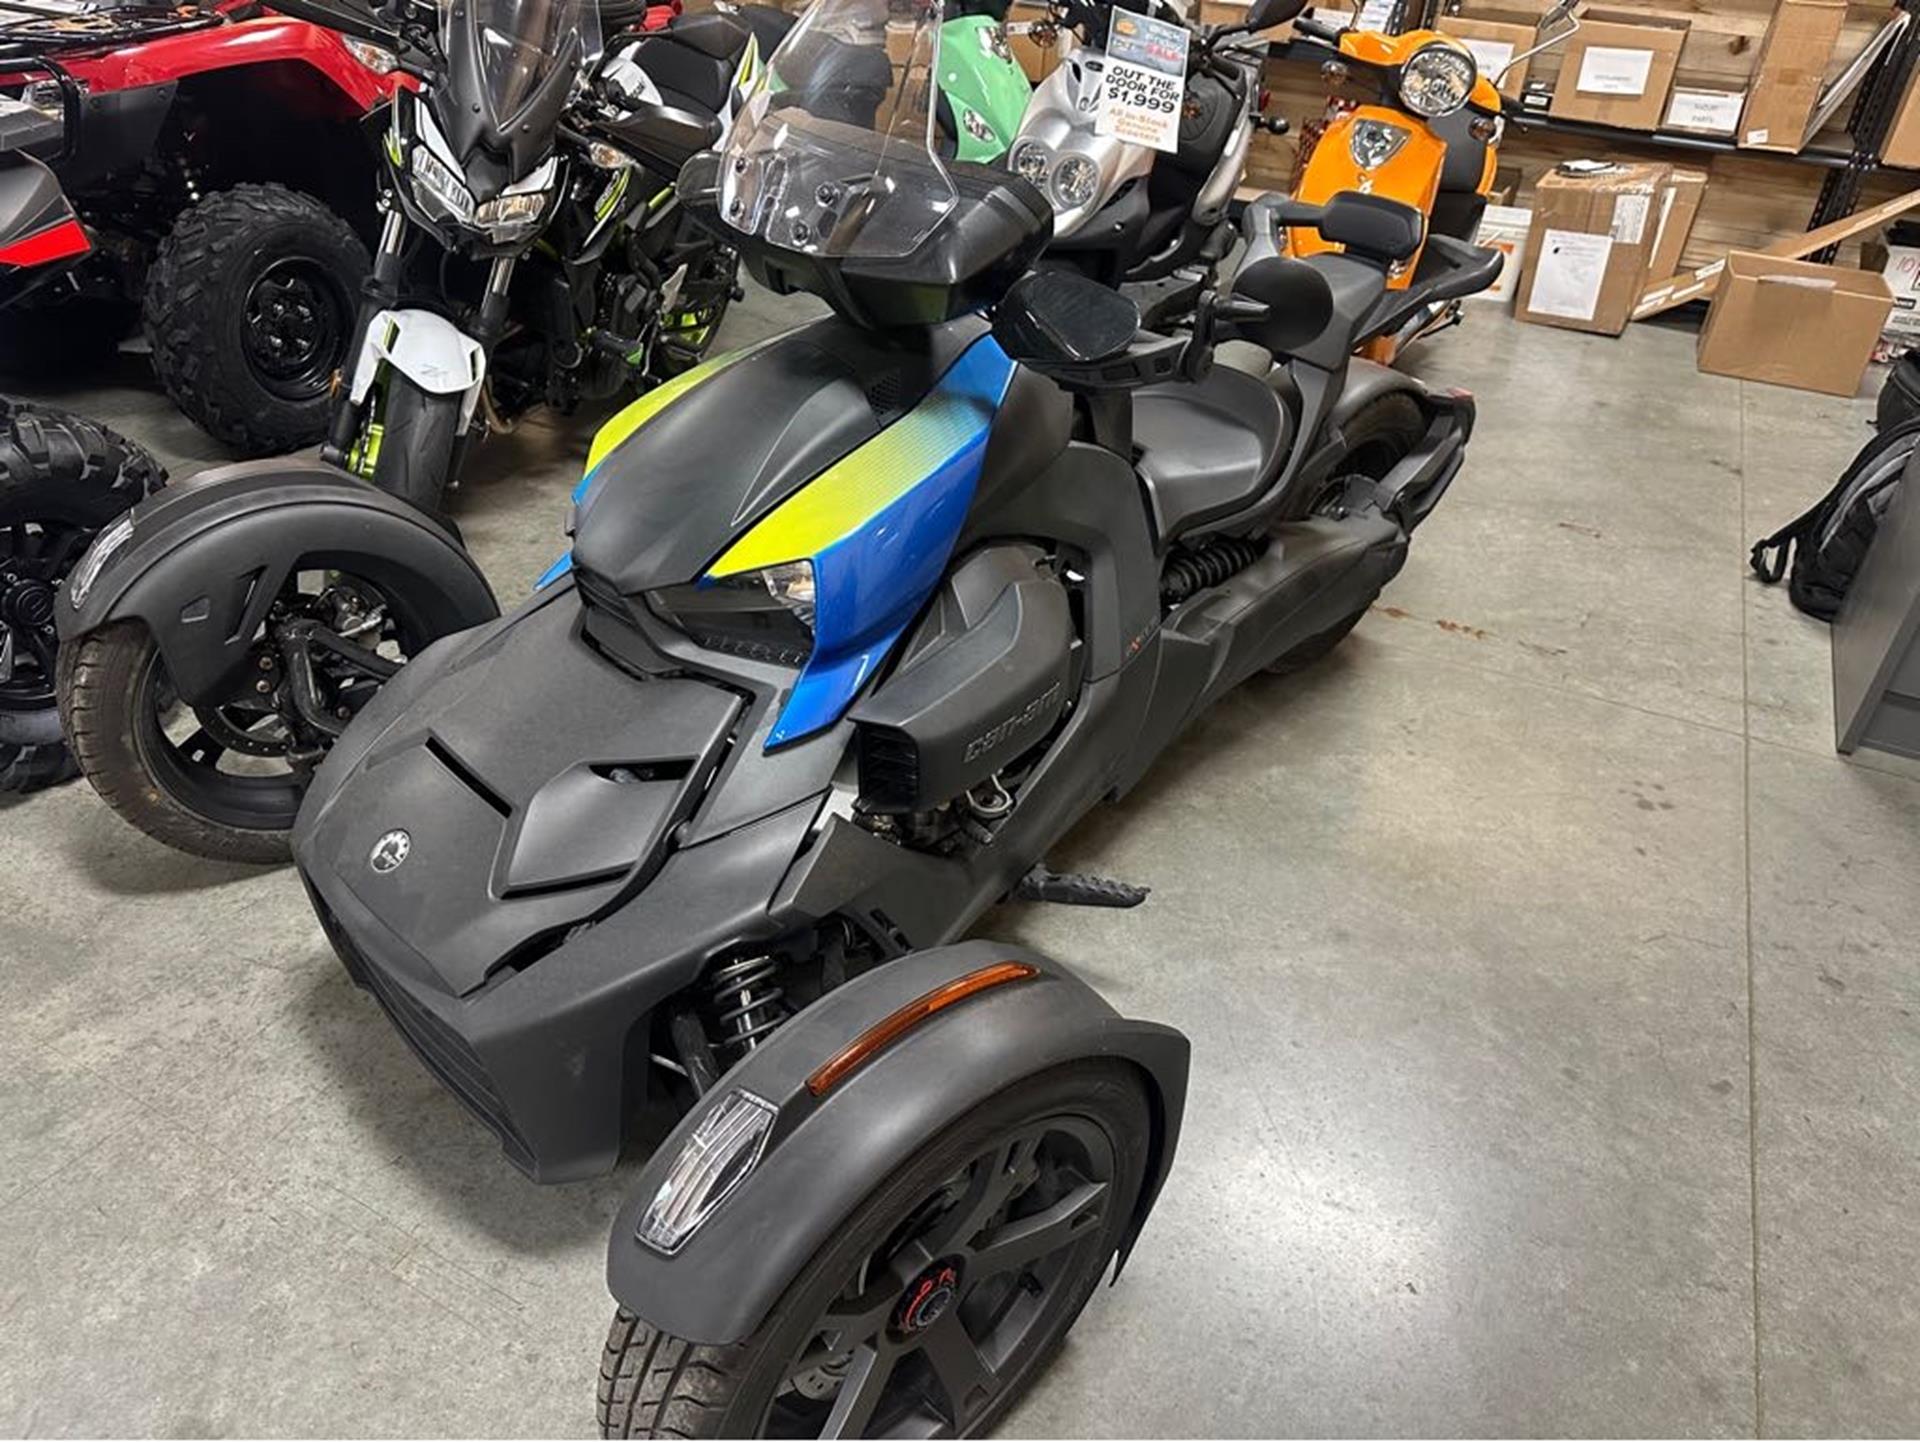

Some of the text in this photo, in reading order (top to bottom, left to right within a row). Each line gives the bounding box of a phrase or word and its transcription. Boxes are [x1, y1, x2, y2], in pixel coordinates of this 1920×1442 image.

[1105, 74, 1180, 101] DOOR FOR
[1113, 65, 1177, 91] OUT THE
[1107, 87, 1175, 114] $1,999
